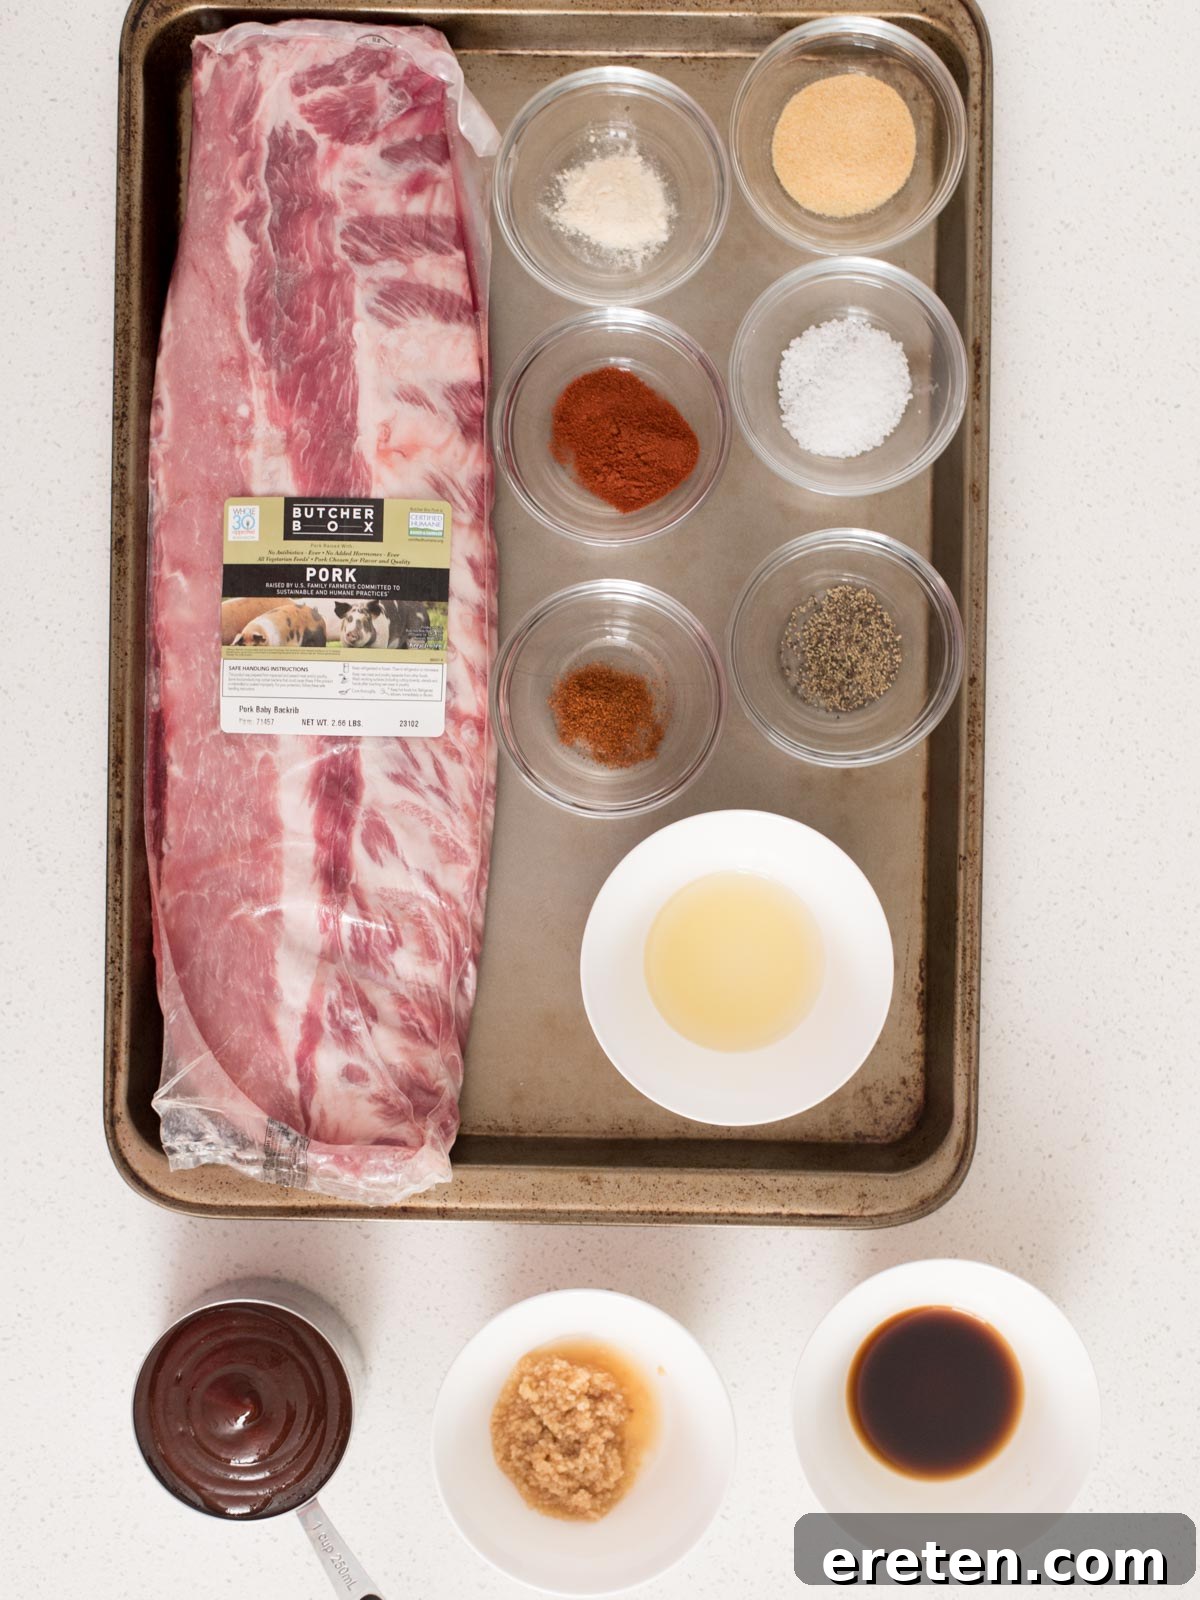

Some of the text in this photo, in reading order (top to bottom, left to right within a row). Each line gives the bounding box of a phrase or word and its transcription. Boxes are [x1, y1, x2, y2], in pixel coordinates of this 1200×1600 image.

[292, 507, 374, 520] BUTCHER
[232, 515, 256, 530] 30
[306, 567, 357, 582] PORK
[255, 705, 271, 715] Baby
[273, 706, 299, 714] Backrib
[316, 719, 329, 727] WT.
[348, 719, 364, 728] LBS.
[399, 720, 419, 728] 23102
[312, 1520, 358, 1592] 1 cup 250mL
